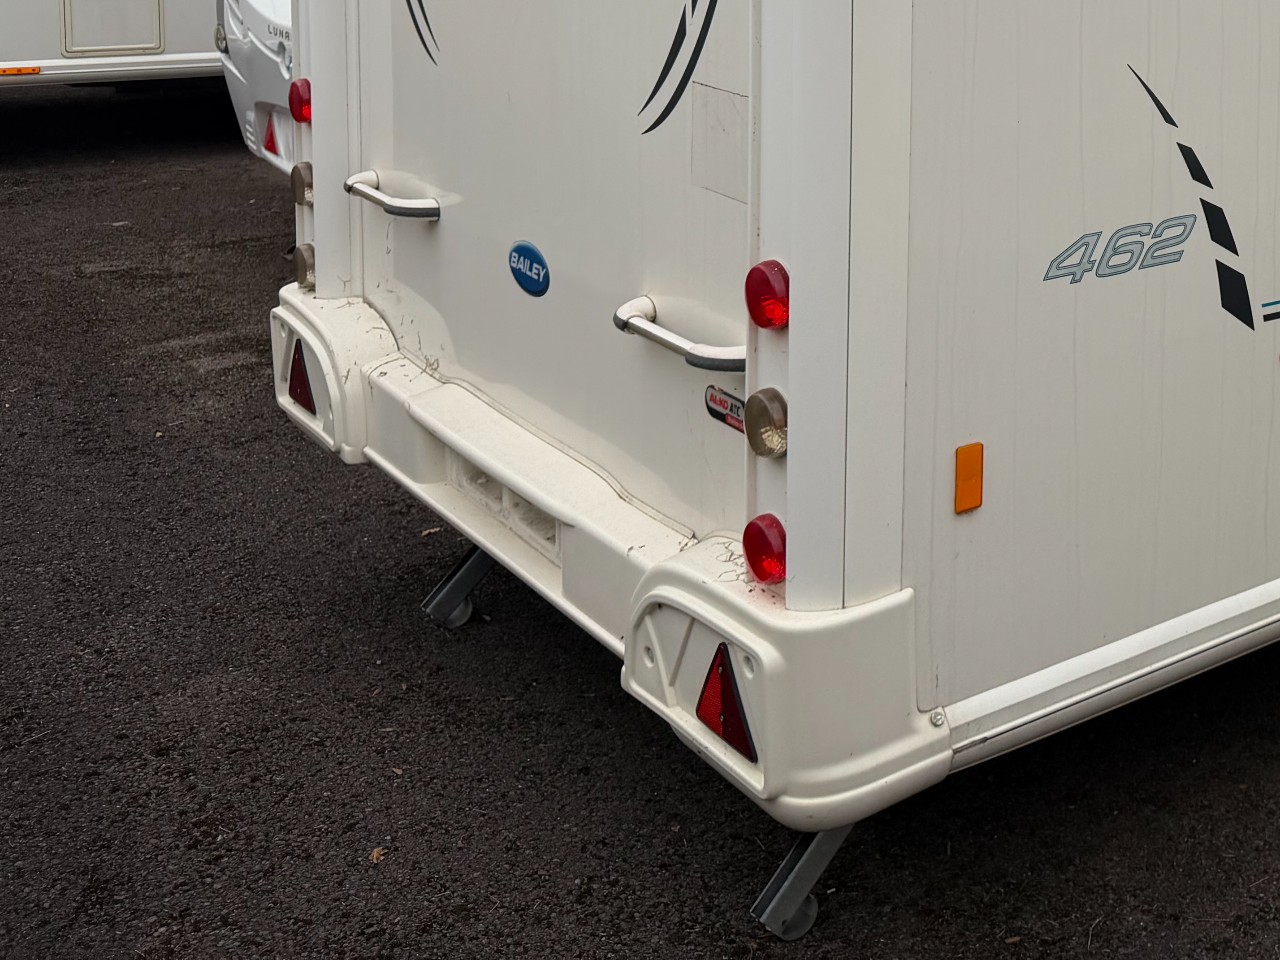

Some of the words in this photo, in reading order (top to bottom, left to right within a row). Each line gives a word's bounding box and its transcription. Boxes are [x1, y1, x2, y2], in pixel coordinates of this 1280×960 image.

[1043, 213, 1197, 285] 462
[510, 251, 547, 283] BAILEY
[729, 401, 742, 418] ATC
